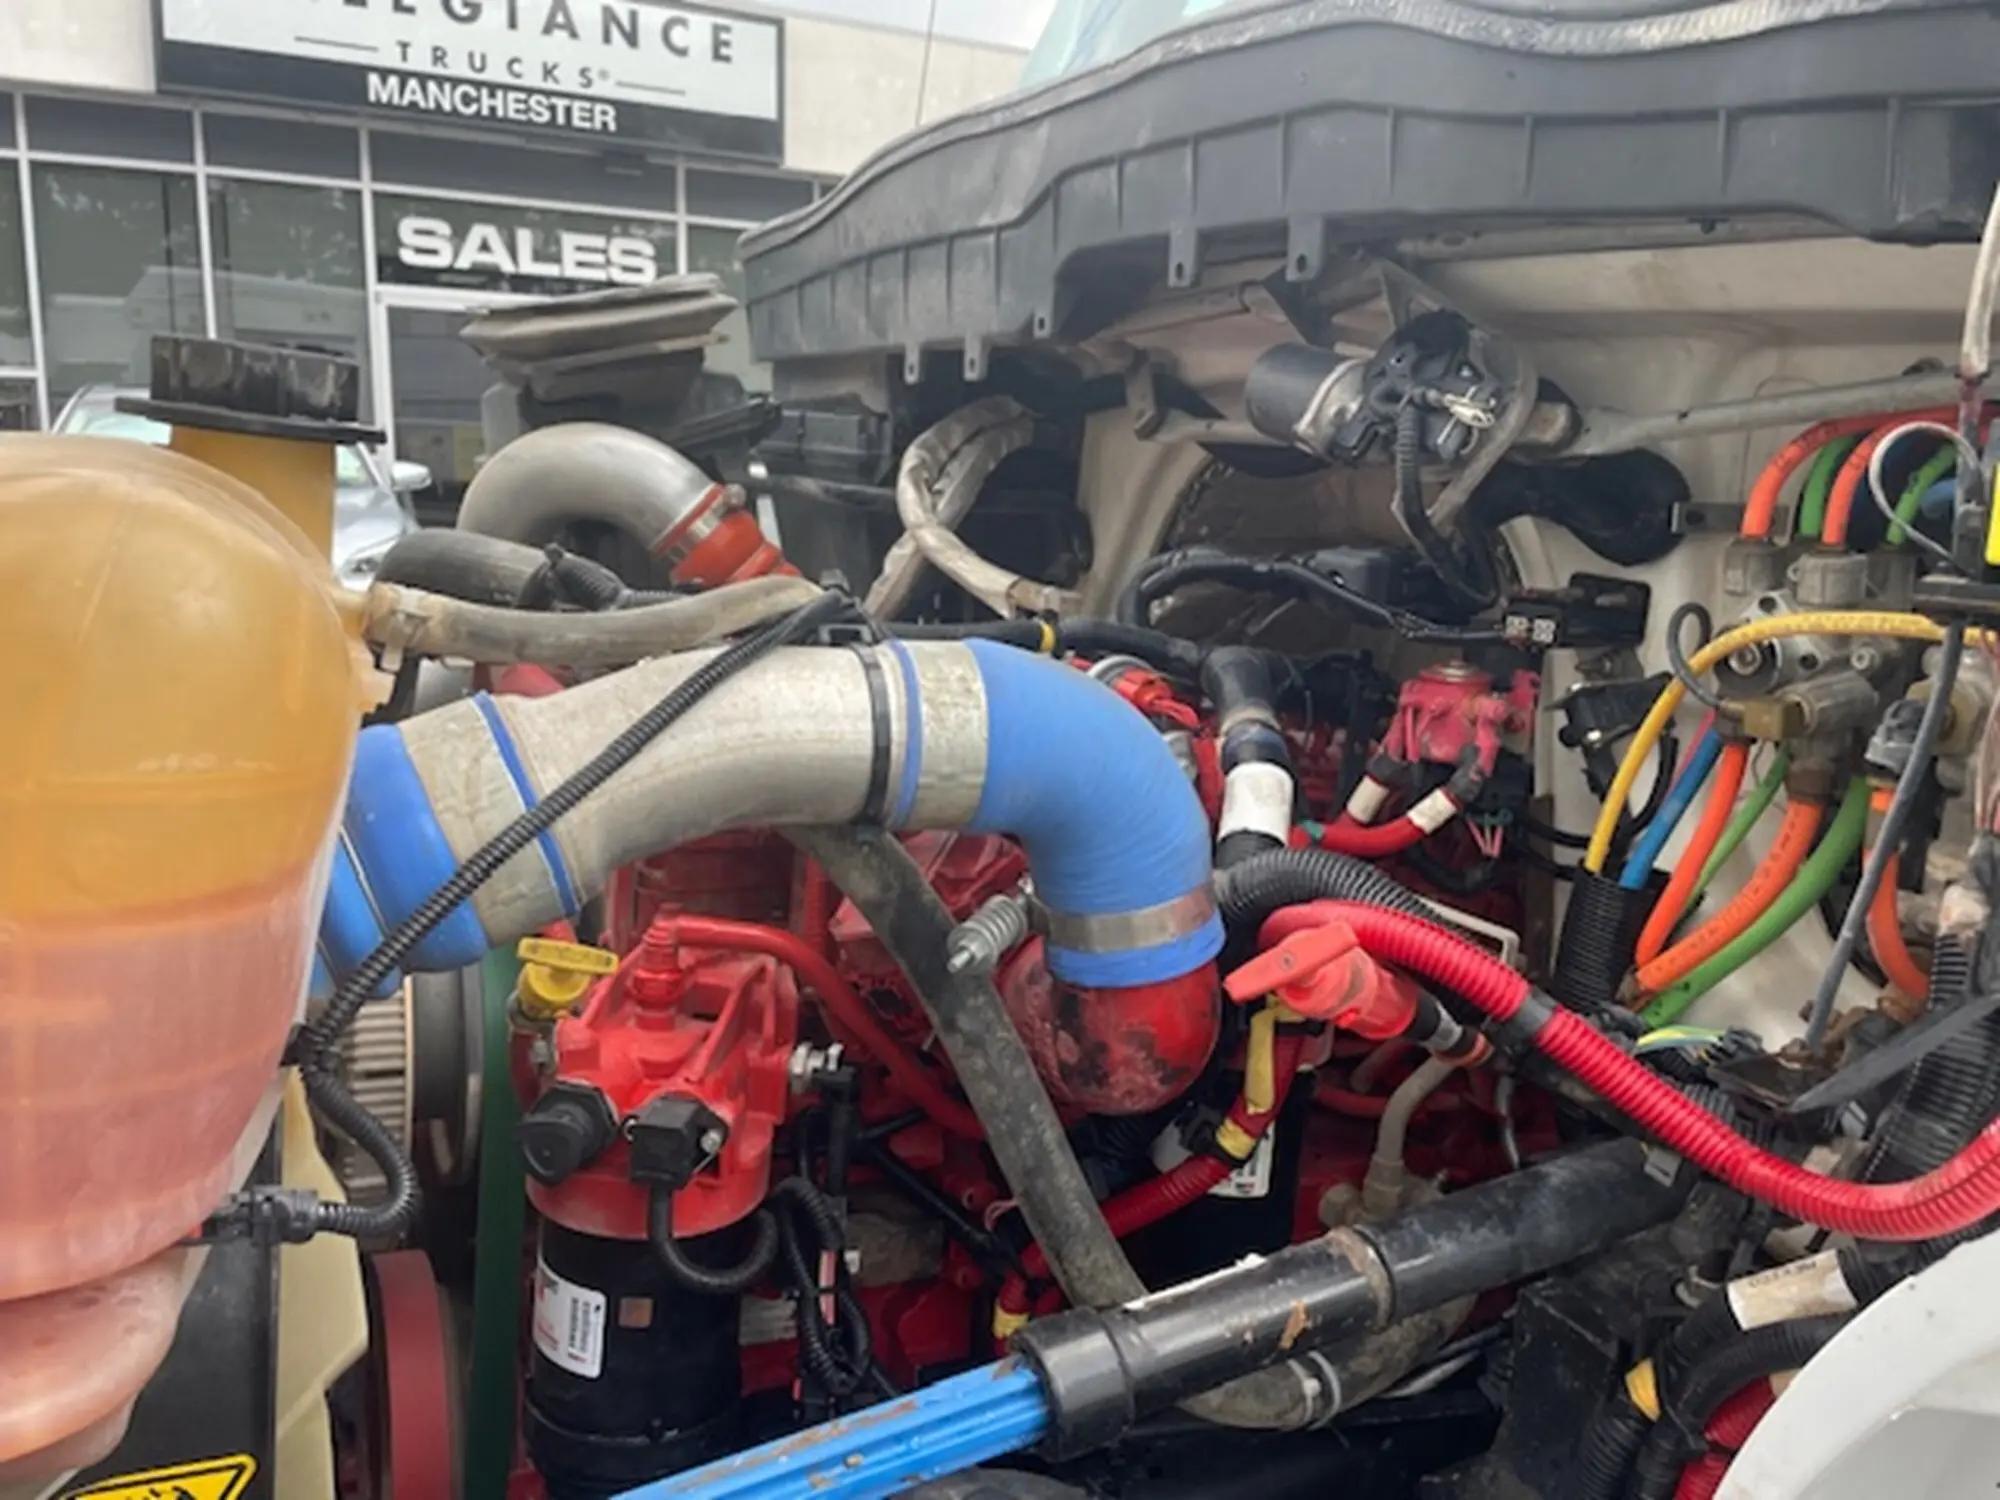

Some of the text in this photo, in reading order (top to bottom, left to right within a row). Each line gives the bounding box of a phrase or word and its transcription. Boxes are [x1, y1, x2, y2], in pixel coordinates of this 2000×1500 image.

[343, 0, 732, 63] GIANCE
[366, 71, 617, 132] MANCHESTER
[397, 216, 657, 285] SALES
